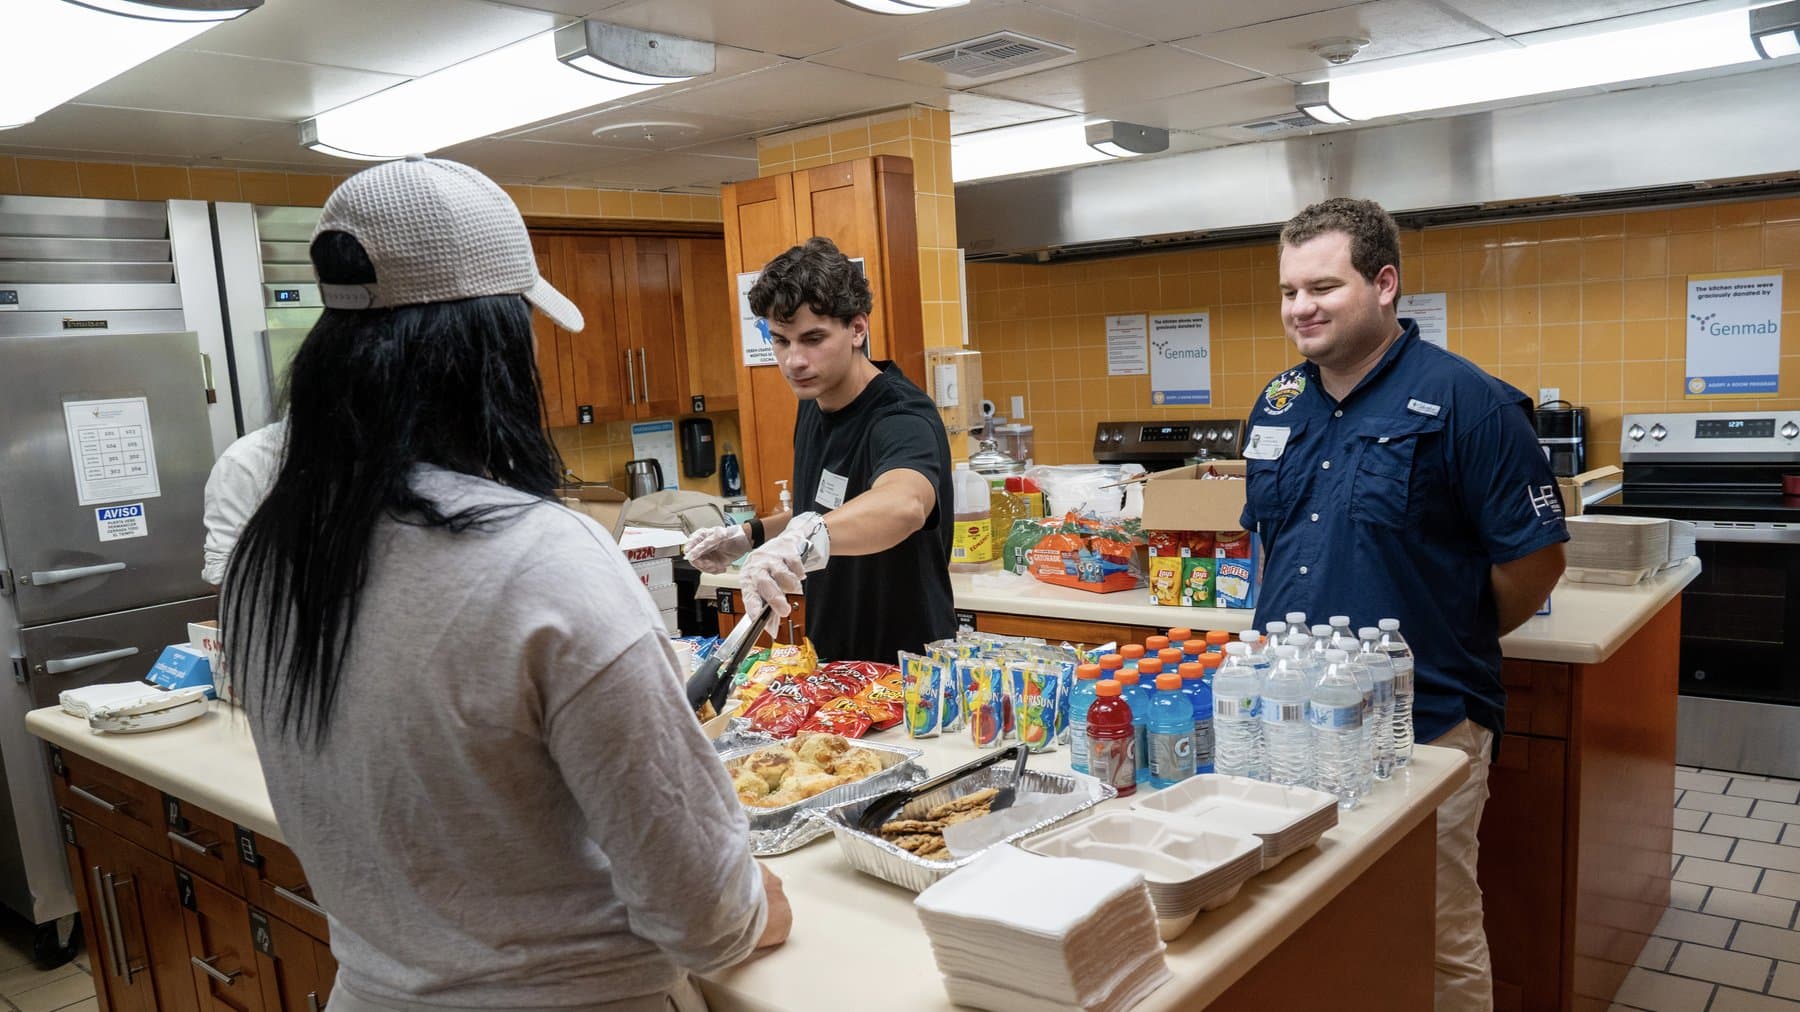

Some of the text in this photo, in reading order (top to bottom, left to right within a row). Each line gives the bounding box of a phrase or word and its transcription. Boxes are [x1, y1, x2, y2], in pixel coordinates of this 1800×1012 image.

[1709, 319, 1778, 336] Genmab
[1164, 346, 1208, 360] Genmab
[103, 506, 138, 520] AVISO
[627, 545, 656, 561] PIZZA!
[1220, 563, 1249, 580] RUFFLES
[1174, 736, 1190, 757] G
